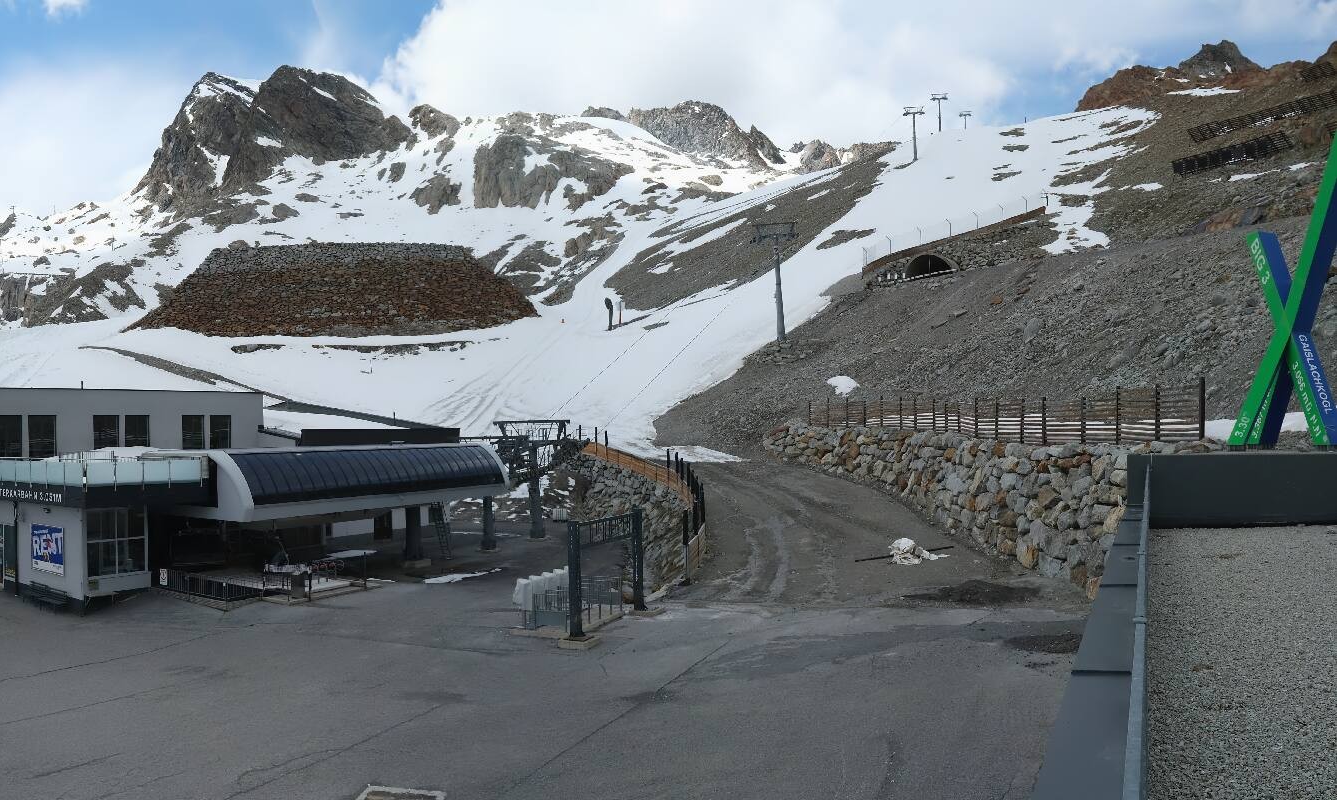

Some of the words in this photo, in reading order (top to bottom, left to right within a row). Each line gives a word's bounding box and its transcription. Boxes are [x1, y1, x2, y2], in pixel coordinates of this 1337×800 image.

[1250, 237, 1266, 271] BIG
[1261, 270, 1270, 284] 3
[1298, 334, 1333, 414] GAISLACHKOGL
[1234, 411, 1251, 438] 3.30
[32, 532, 63, 557] RENT
